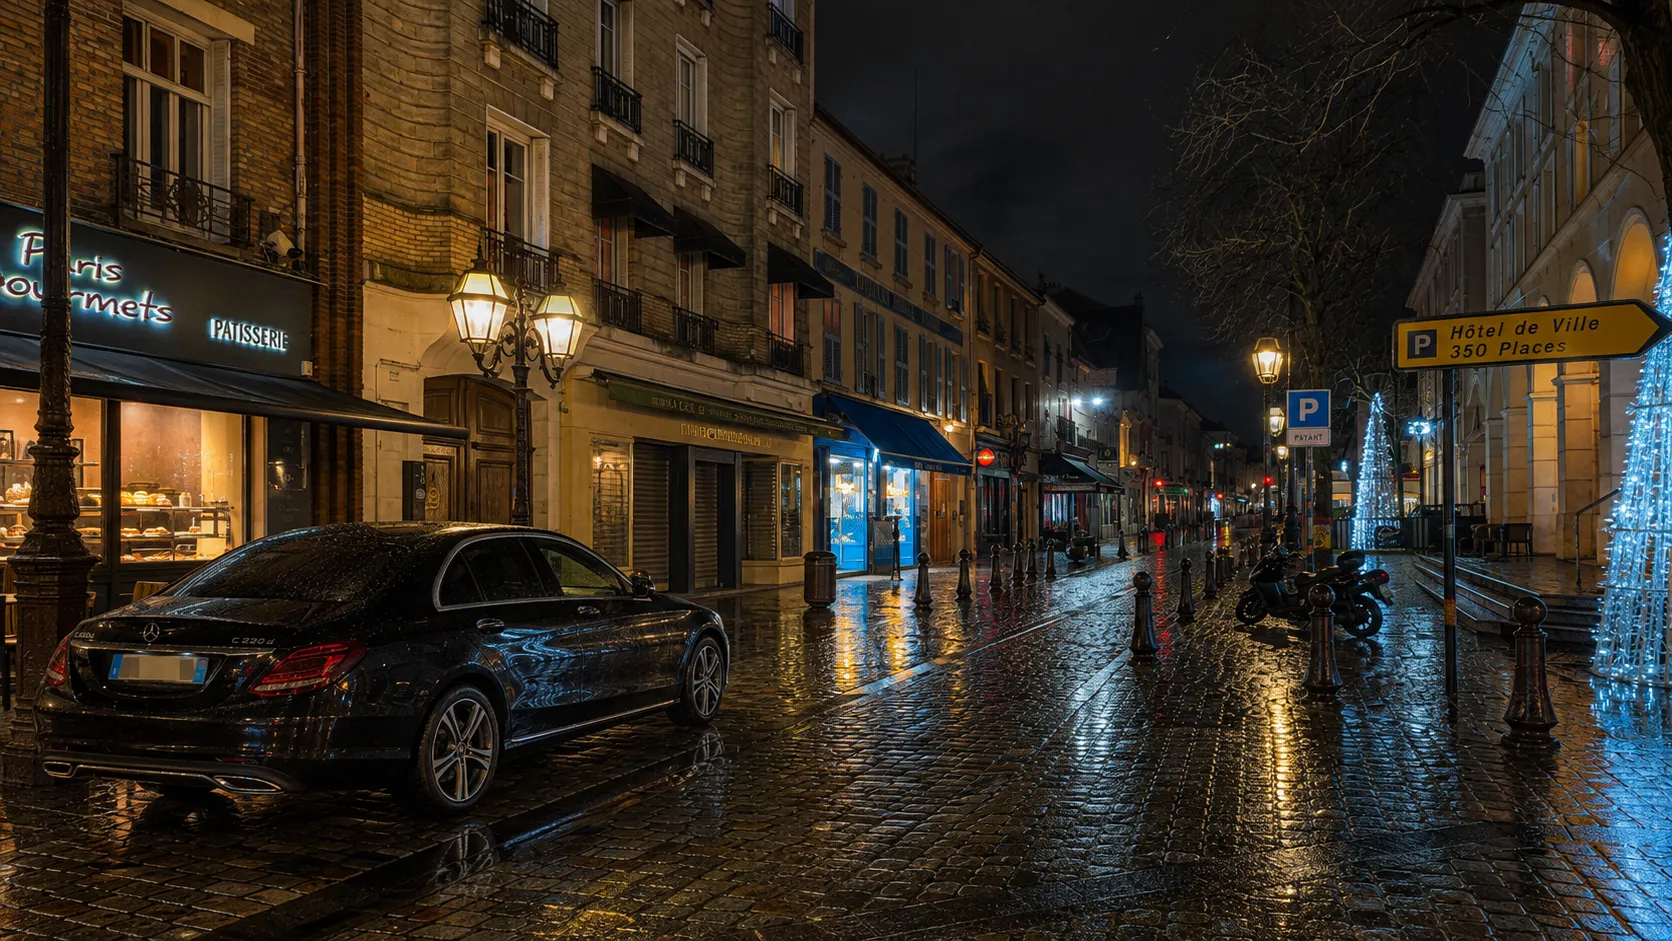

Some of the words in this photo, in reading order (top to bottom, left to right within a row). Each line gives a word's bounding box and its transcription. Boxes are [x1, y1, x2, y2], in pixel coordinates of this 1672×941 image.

[19, 230, 123, 281] Pris
[211, 318, 289, 350] PATISSERIE
[1450, 321, 1505, 340] Hôtel
[1515, 320, 1539, 336] de
[1553, 316, 1600, 333] Ville
[1414, 334, 1432, 355] P
[1450, 344, 1488, 359] 350
[1499, 340, 1567, 356] Places
[1299, 397, 1319, 422] P
